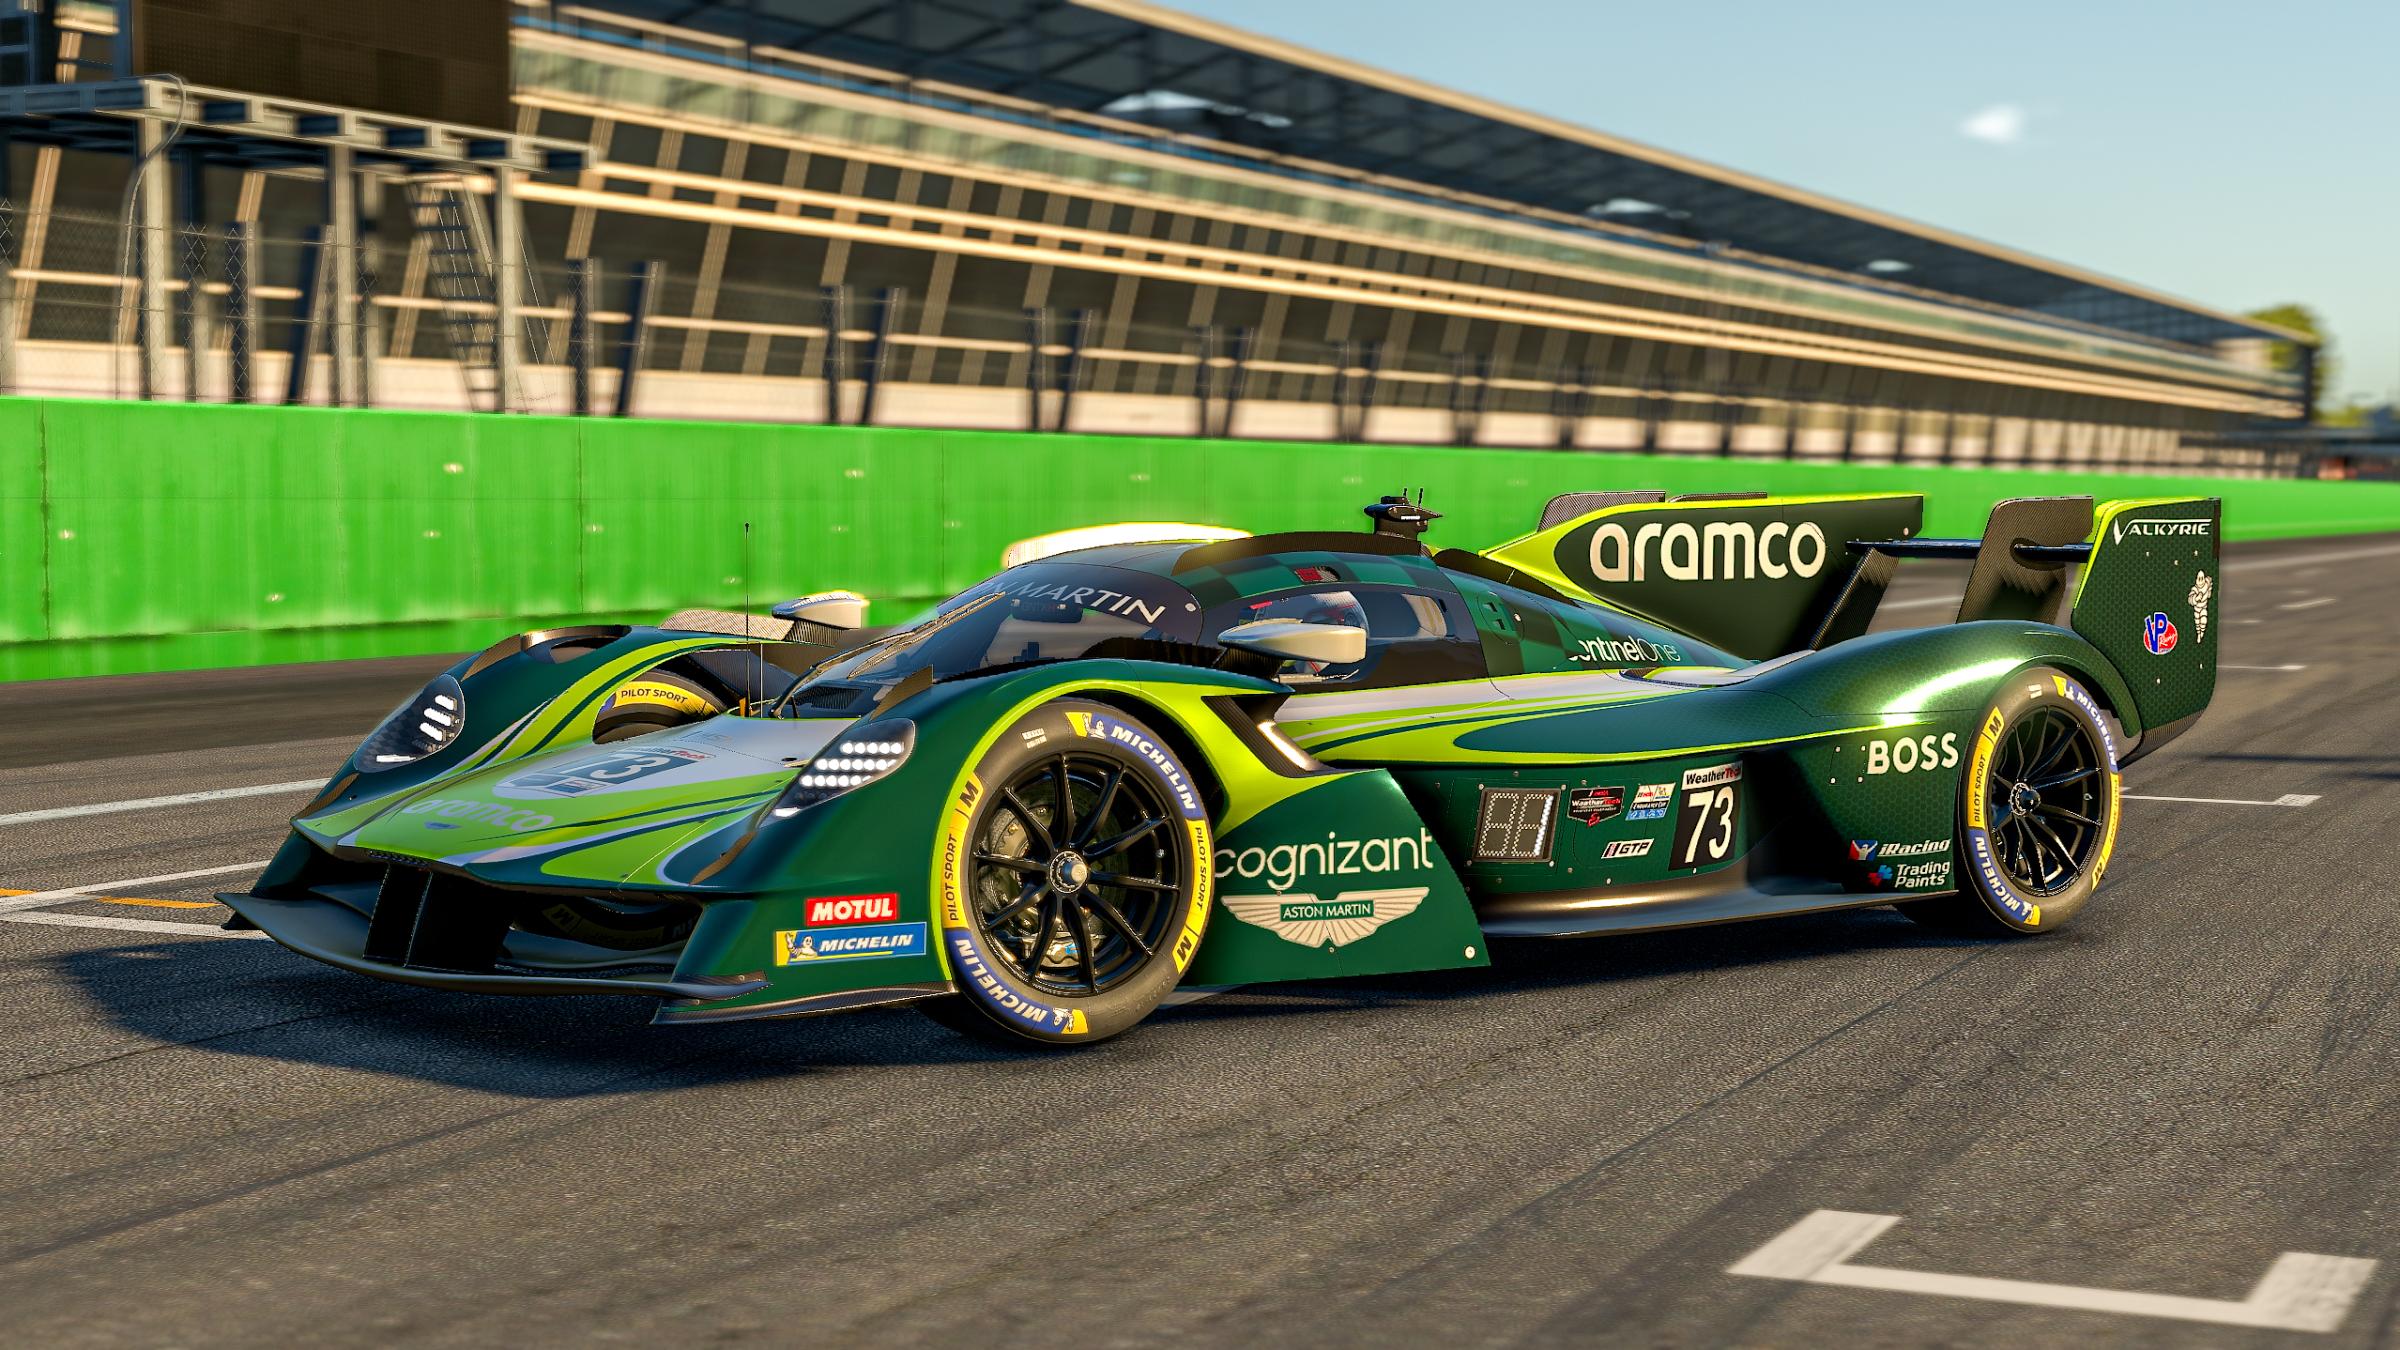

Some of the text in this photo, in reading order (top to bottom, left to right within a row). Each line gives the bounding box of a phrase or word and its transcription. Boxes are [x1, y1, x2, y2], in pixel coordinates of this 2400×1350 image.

[1590, 521, 1826, 582] aramco
[2113, 518, 2212, 545] VALKYRIE
[1006, 582, 1166, 624] MARTIN
[2144, 612, 2169, 653] VP
[621, 688, 688, 704] PILOT SPORT
[2075, 691, 2117, 767] MICHELIN
[1110, 725, 1196, 810] MICHELIN
[1867, 732, 1959, 774] BOSS
[959, 780, 979, 809] M
[1974, 754, 1987, 823] PILOT SPORT
[1685, 786, 1734, 863] 73
[1214, 827, 1434, 891] cognizant
[1619, 842, 1651, 854] GTP
[1879, 839, 1952, 856] iRacing
[944, 833, 959, 922] PILOT SPORT
[1195, 827, 1207, 912] PILOT SPORT
[1894, 874, 1945, 889] Paints
[1897, 861, 1950, 876] Trading
[1974, 836, 2021, 912] MICHELIN
[811, 898, 893, 921] MOTUL
[1283, 903, 1371, 918] ASTON MARTIN
[819, 935, 914, 952] MICHELIN
[1176, 935, 1193, 962] M
[955, 938, 1048, 1023] MICHELIN
